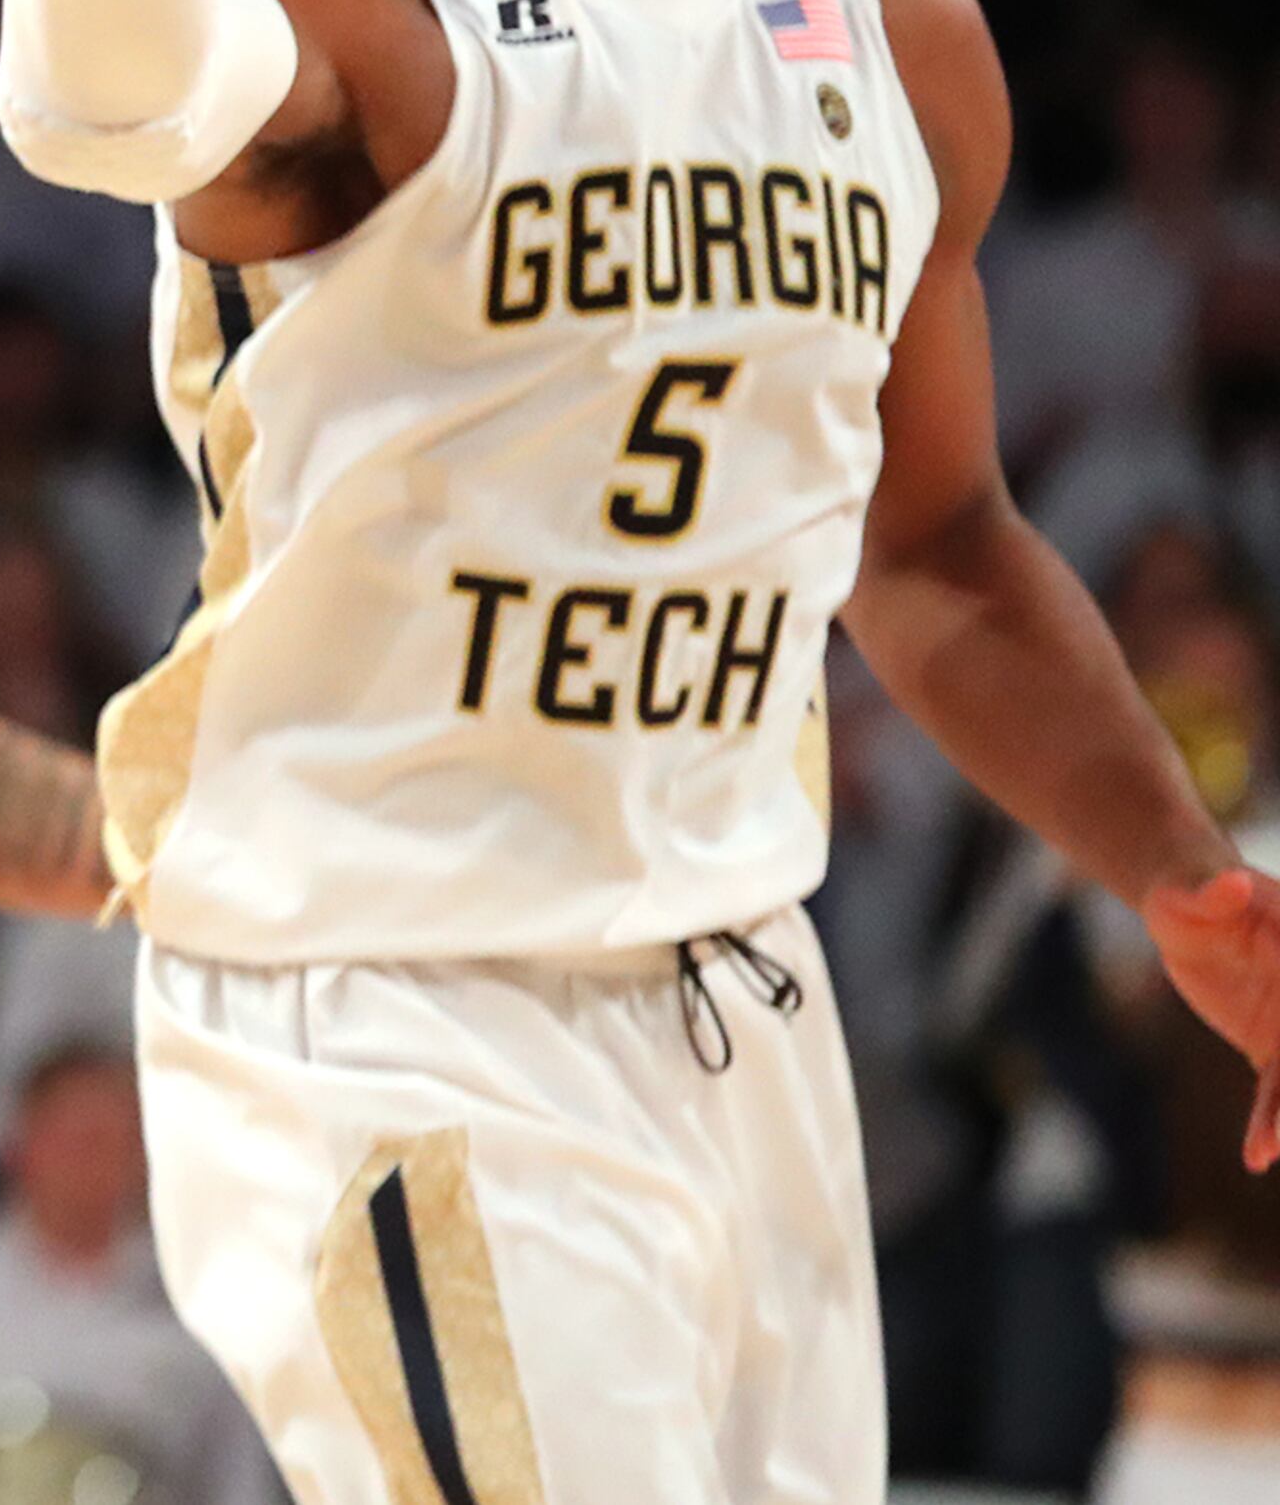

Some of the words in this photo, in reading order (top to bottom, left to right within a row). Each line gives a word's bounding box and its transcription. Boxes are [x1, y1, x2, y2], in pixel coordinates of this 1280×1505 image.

[485, 160, 890, 340] GEORGIA
[600, 353, 744, 547] 5
[448, 566, 790, 734] TECH
